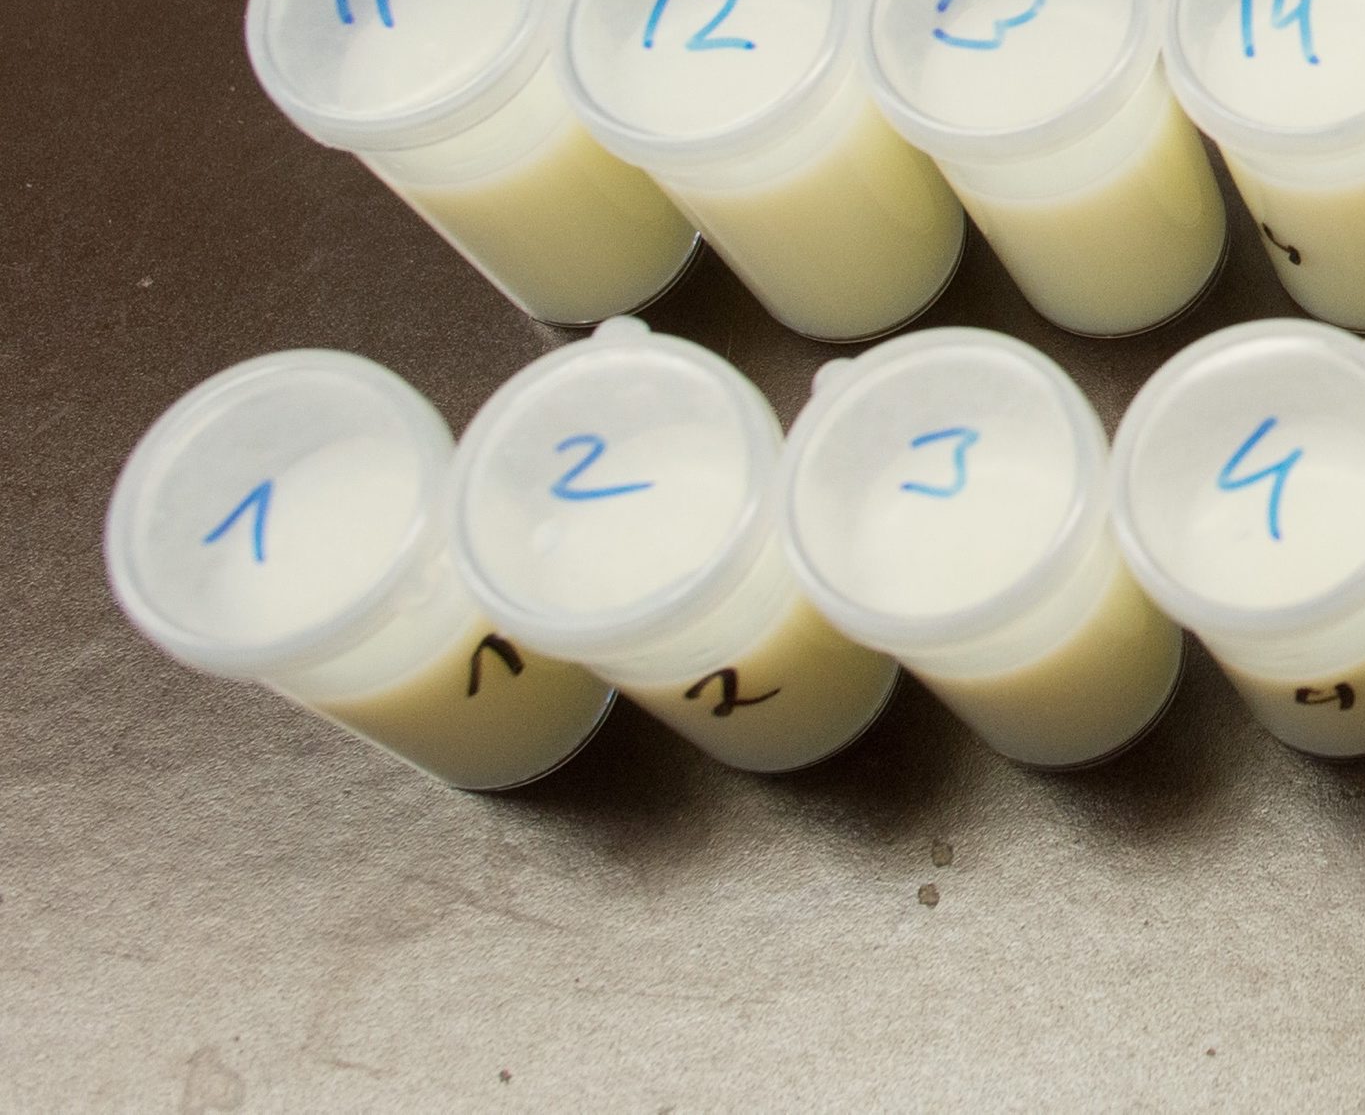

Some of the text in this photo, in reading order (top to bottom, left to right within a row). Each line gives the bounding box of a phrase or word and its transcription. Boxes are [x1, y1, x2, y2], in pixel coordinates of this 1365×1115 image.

[551, 434, 651, 503] 2
[901, 427, 978, 498] 3
[1217, 416, 1303, 541] 4
[202, 479, 274, 564] 1
